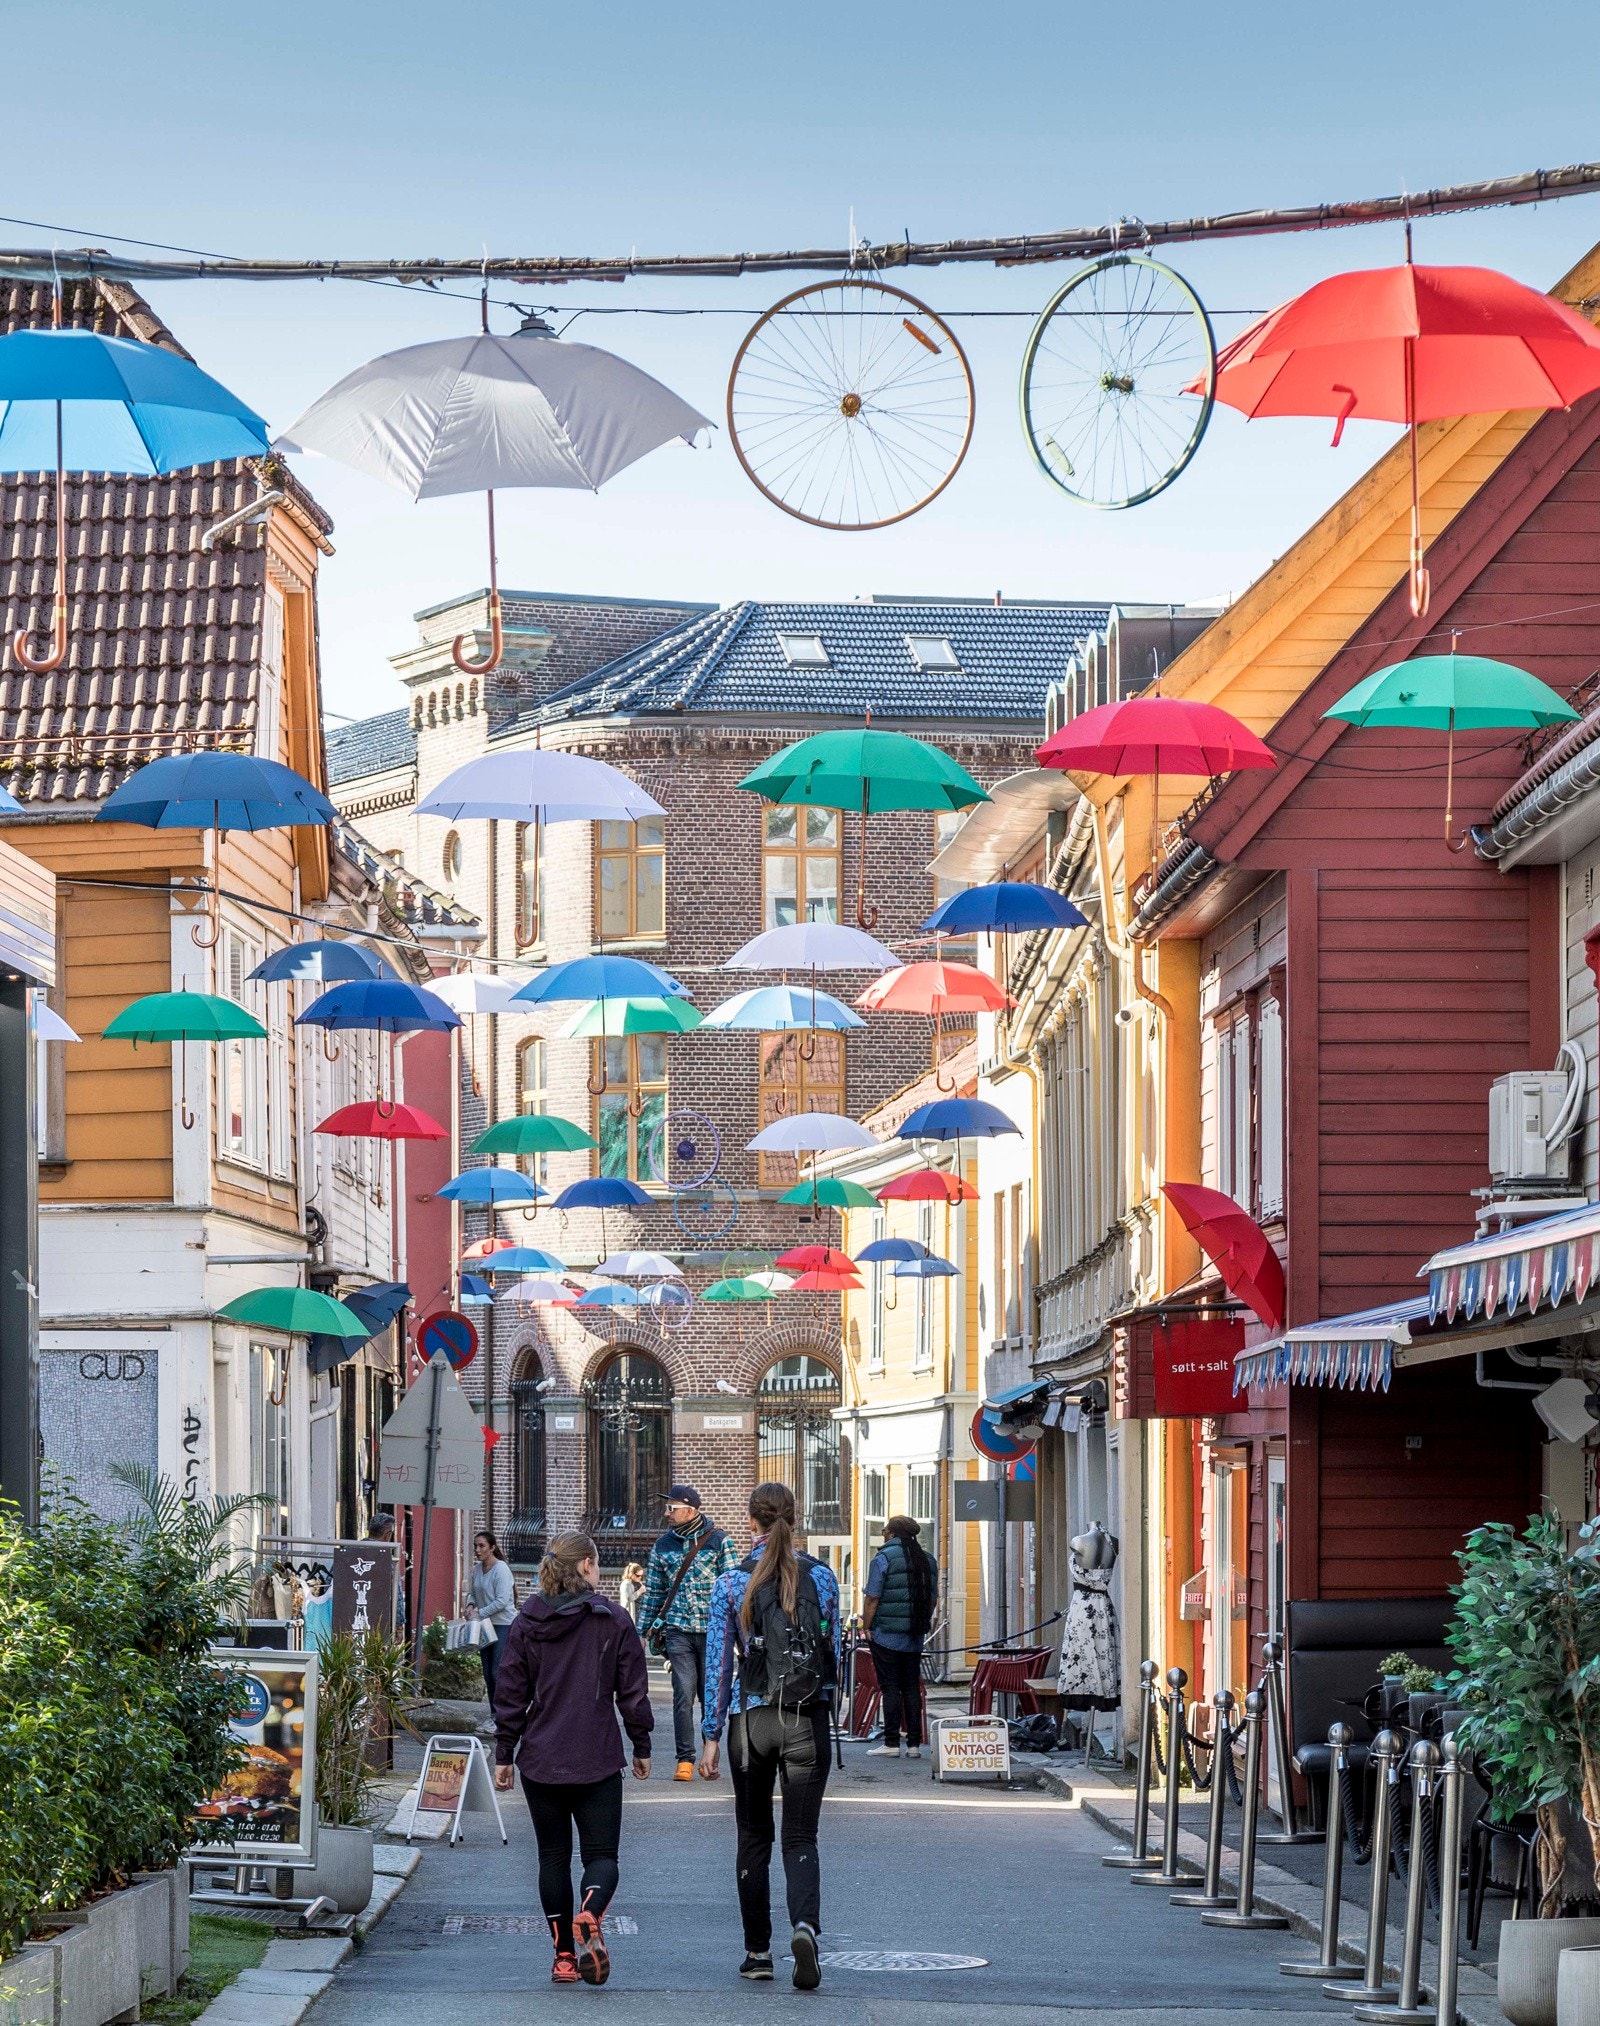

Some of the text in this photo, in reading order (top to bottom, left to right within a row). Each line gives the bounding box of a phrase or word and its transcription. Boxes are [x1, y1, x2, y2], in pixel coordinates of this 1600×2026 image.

[1171, 1362, 1196, 1372] søtt
[1206, 1360, 1228, 1371] salt
[949, 1731, 998, 1742] RETRO
[944, 1744, 1005, 1755] VINTAGE
[430, 1757, 454, 1769] Barne
[947, 1757, 1003, 1768] SYSTUE
